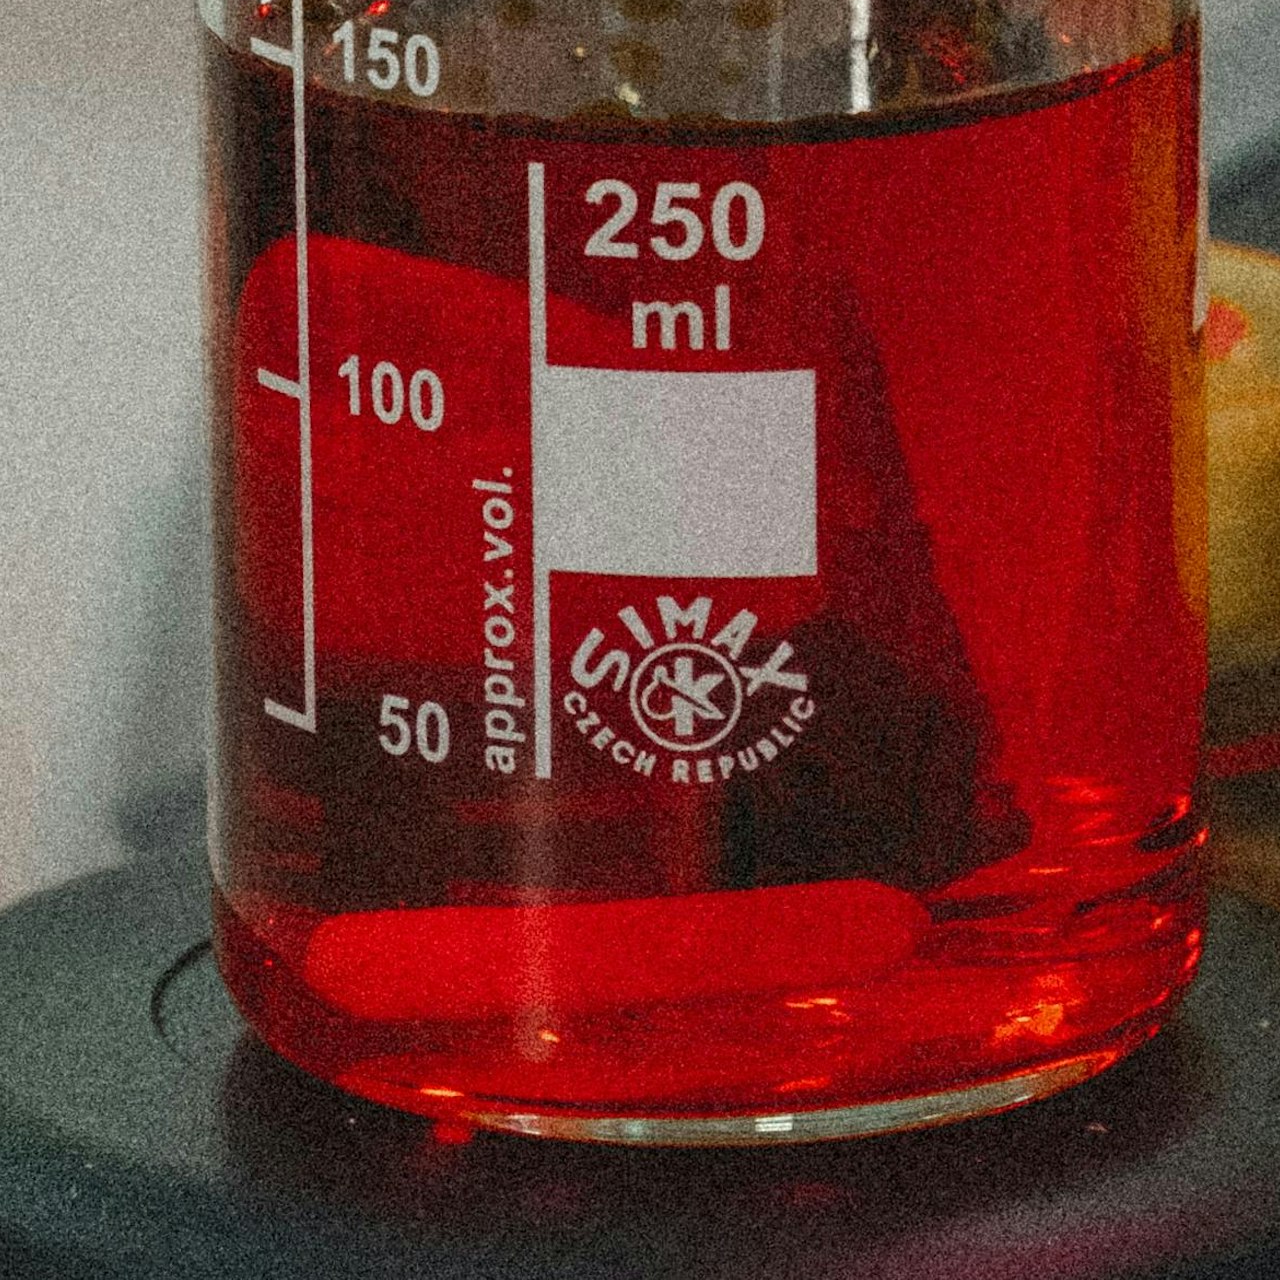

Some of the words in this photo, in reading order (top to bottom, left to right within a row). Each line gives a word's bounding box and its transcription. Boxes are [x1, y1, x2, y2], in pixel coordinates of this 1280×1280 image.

[331, 20, 441, 97] 150
[584, 178, 766, 261] 250
[631, 283, 731, 351] ml
[337, 354, 445, 432] 100
[471, 467, 526, 775] approx.vol.
[570, 595, 809, 697] SIMAX
[379, 693, 452, 764] 50
[562, 690, 658, 776] CZECH
[671, 696, 815, 784] REPUBLIC
